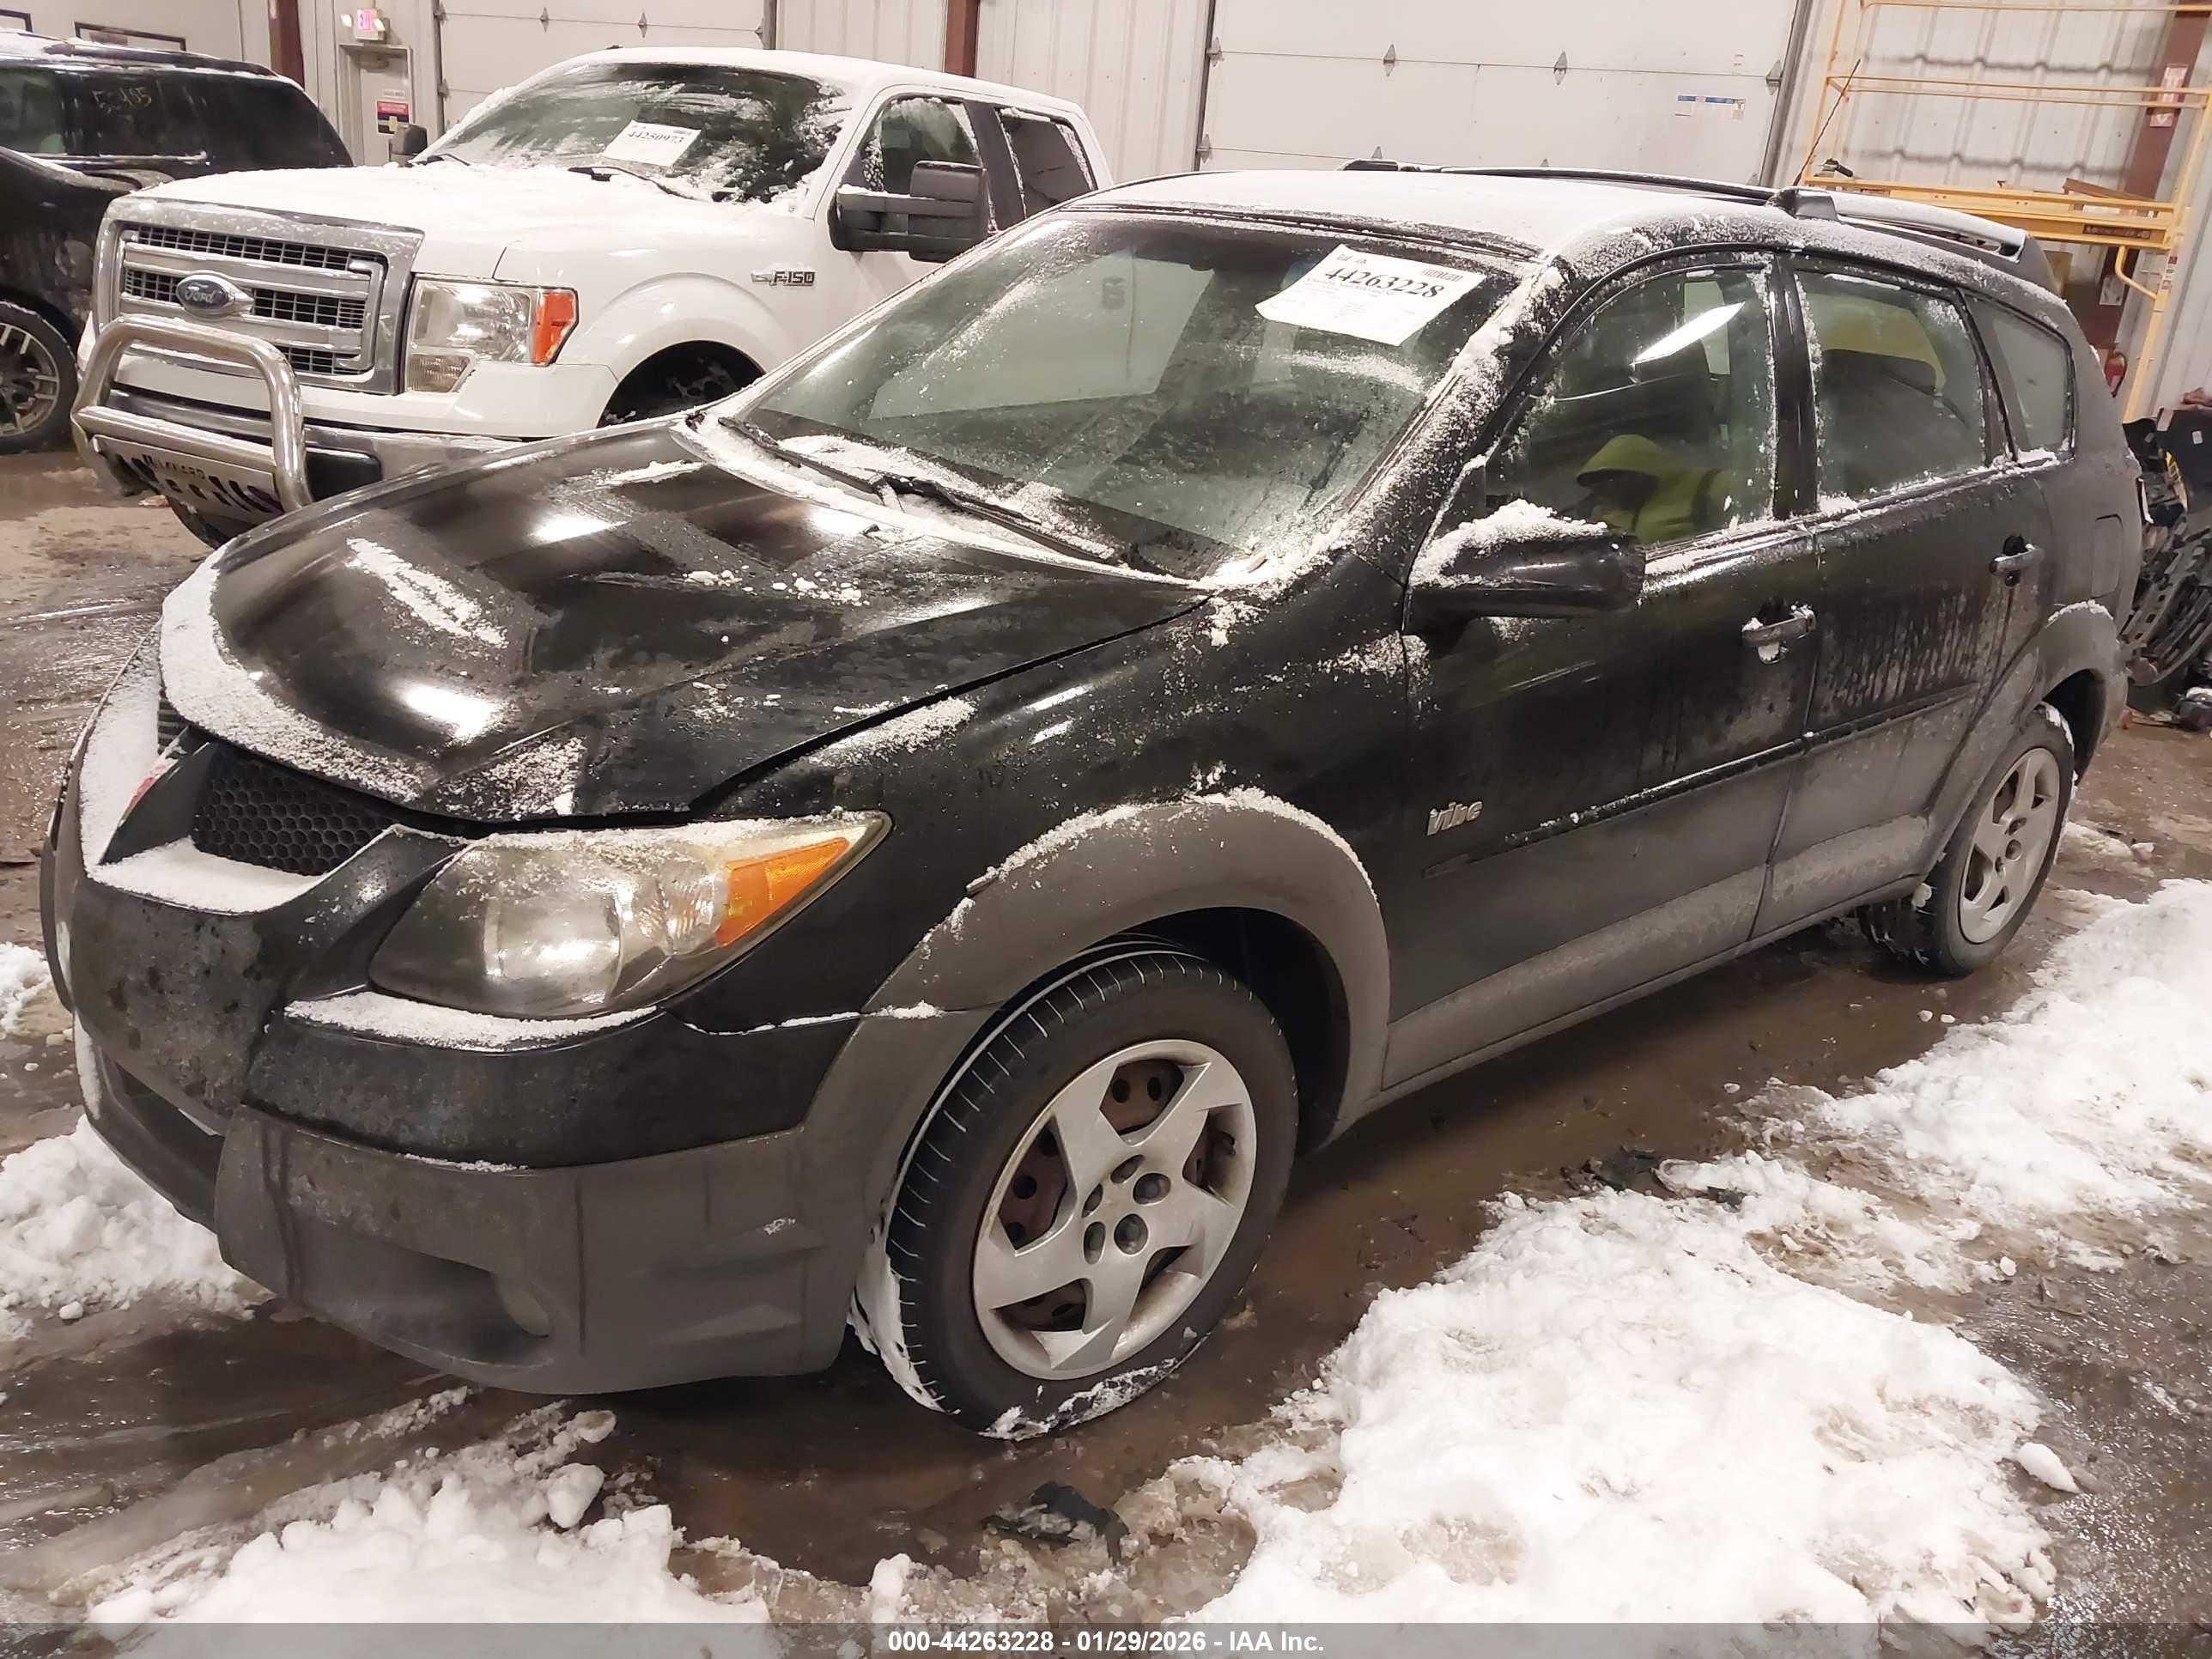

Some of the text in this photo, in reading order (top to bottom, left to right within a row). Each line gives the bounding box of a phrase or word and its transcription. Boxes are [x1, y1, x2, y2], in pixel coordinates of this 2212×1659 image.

[774, 270, 815, 284] F-150
[1324, 267, 1444, 298] 44263228
[185, 282, 218, 304] Ford
